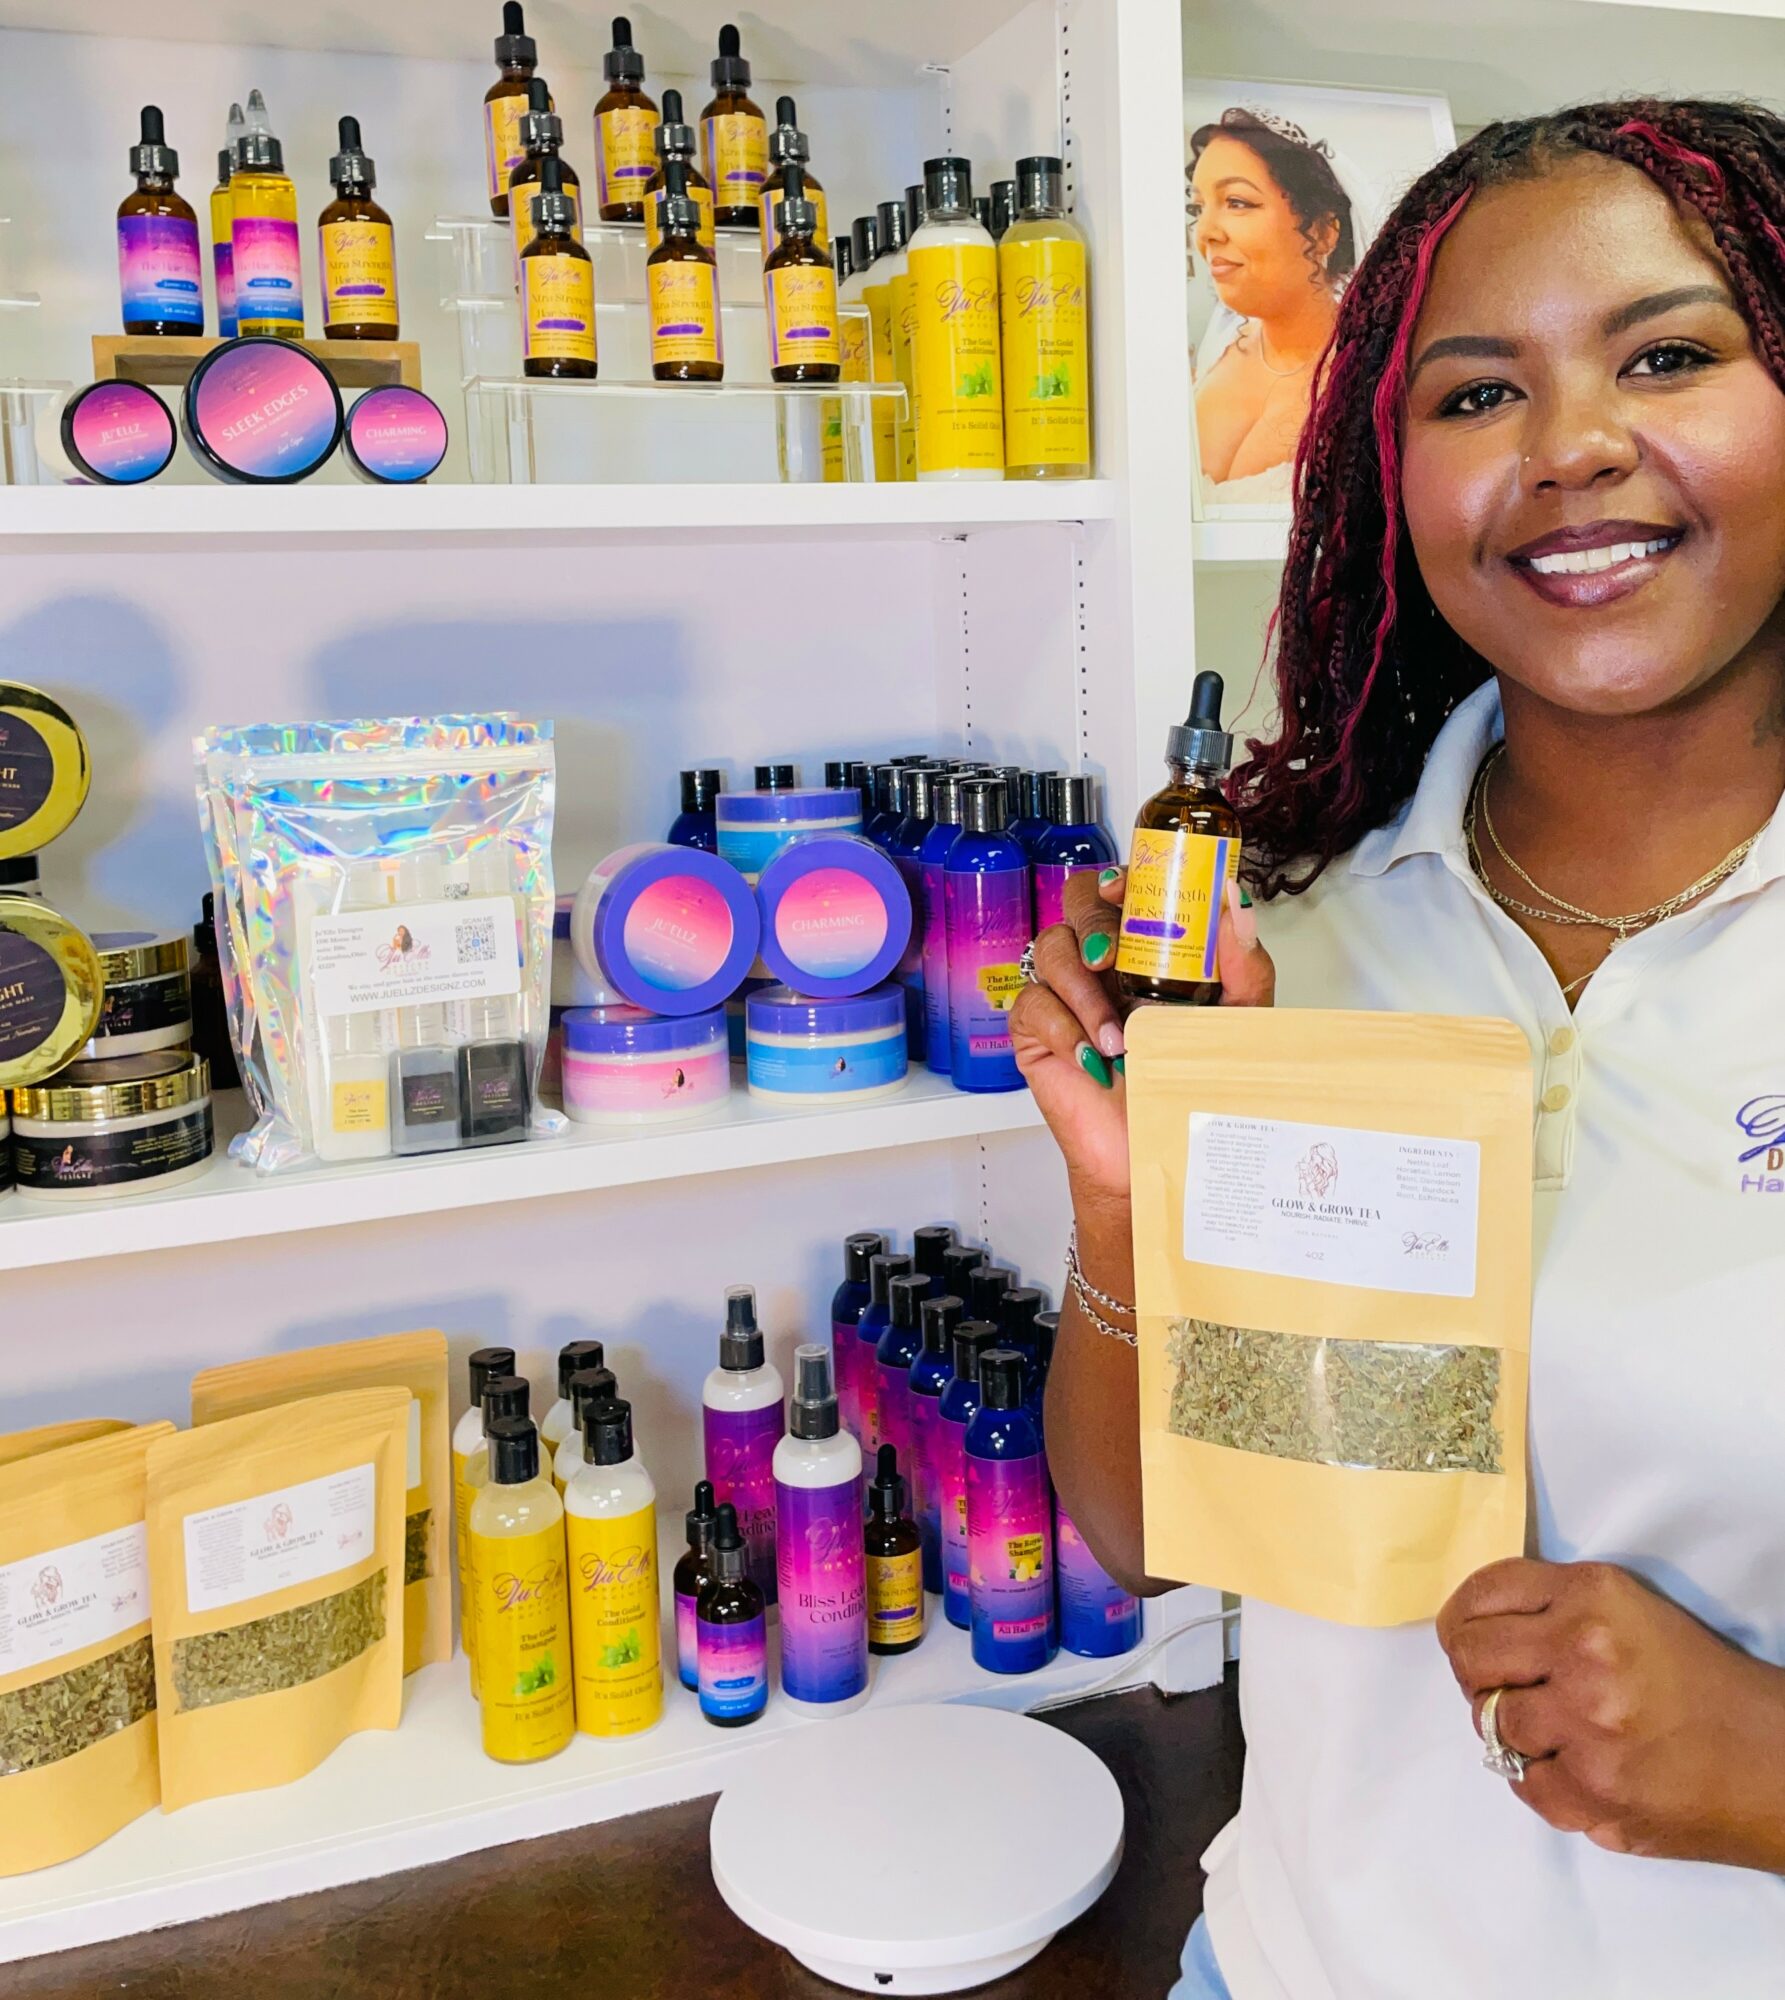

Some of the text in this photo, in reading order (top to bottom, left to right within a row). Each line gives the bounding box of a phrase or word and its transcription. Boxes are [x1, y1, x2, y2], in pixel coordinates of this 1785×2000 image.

[1039, 338, 1055, 348] The
[221, 383, 310, 442] SLEEK EDGES
[365, 425, 427, 439] CHARMING
[791, 914, 866, 932] CHARMING
[986, 974, 1024, 984] The Roya
[349, 978, 487, 1003] WWW.JUELLZDESIGNZ.COM
[974, 1041, 988, 1049] All
[1271, 1197, 1382, 1220] GLOW & GROW TEA
[1007, 1537, 1043, 1551] The Roya
[17, 1610, 44, 1626] GLOW
[53, 1599, 81, 1615] GROW
[82, 1591, 98, 1605] TEA
[799, 1592, 837, 1609] Bliss
[604, 1603, 641, 1619] The Gold
[521, 1625, 558, 1643] The Gold
[998, 1625, 1011, 1635] All
[609, 1687, 634, 1701] Solid
